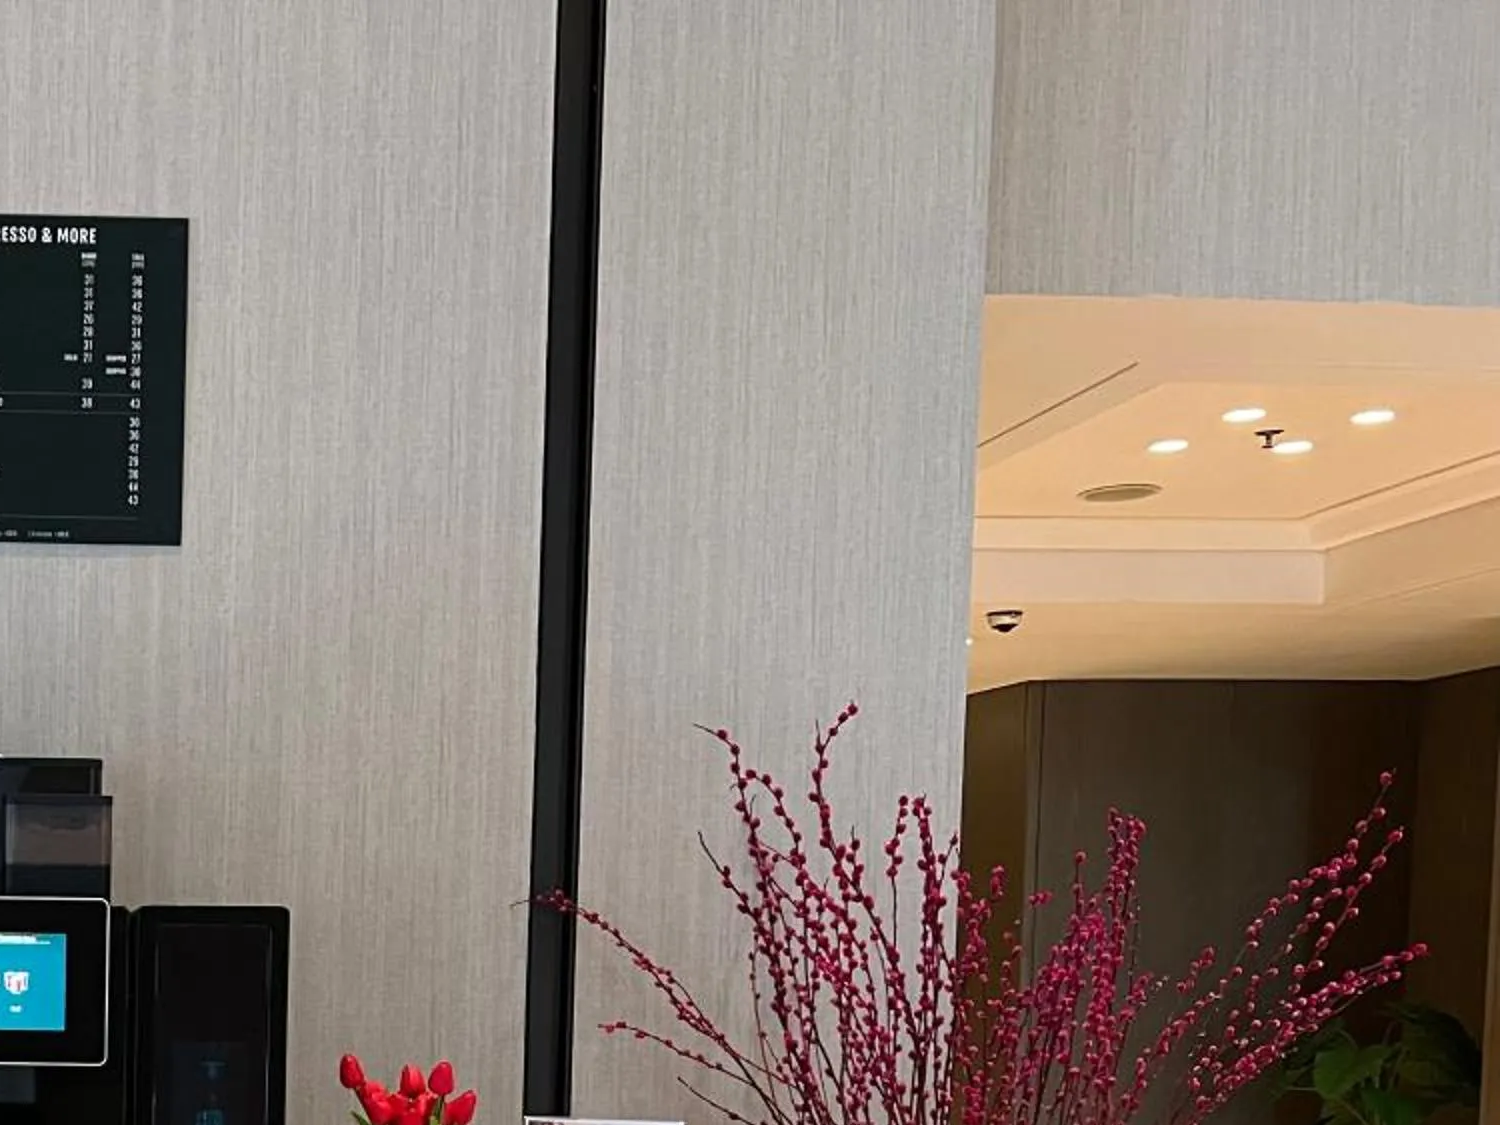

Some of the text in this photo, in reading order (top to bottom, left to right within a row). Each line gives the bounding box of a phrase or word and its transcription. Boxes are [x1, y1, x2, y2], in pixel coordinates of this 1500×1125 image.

[41, 227, 53, 243] &
[57, 227, 97, 244] MORE
[132, 301, 143, 312] 42
